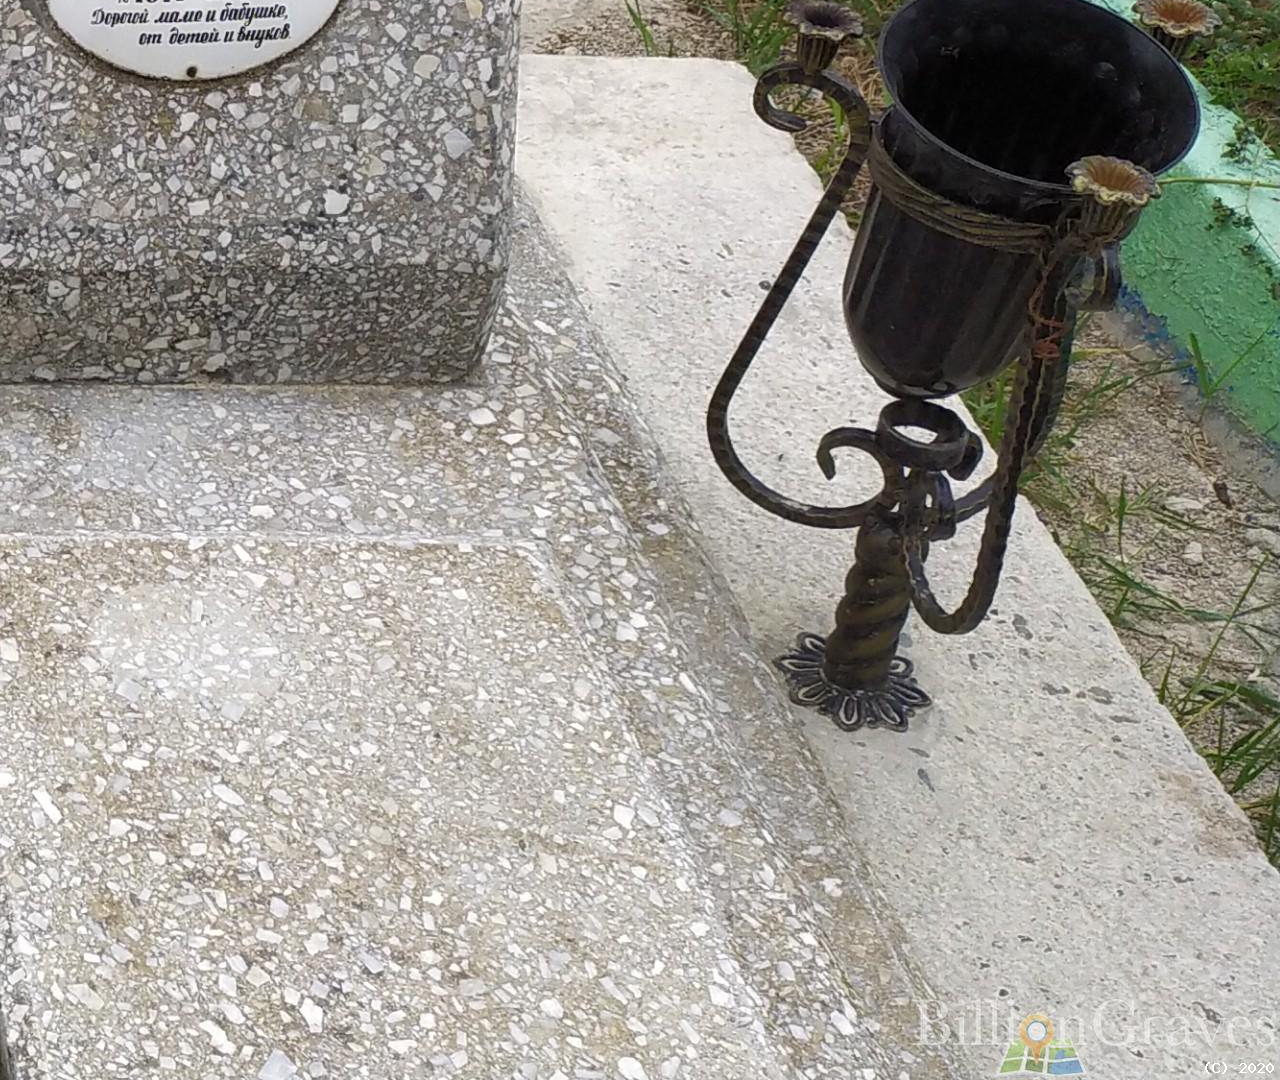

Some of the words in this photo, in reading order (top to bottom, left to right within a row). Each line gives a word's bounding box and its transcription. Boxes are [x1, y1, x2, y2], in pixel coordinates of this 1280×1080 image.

[91, 8, 151, 28] Дорогой
[154, 8, 203, 24] маме
[205, 9, 216, 23] и
[219, 3, 289, 26] бабушке,
[138, 32, 163, 46] от
[168, 27, 222, 45] детей
[223, 29, 235, 43] и
